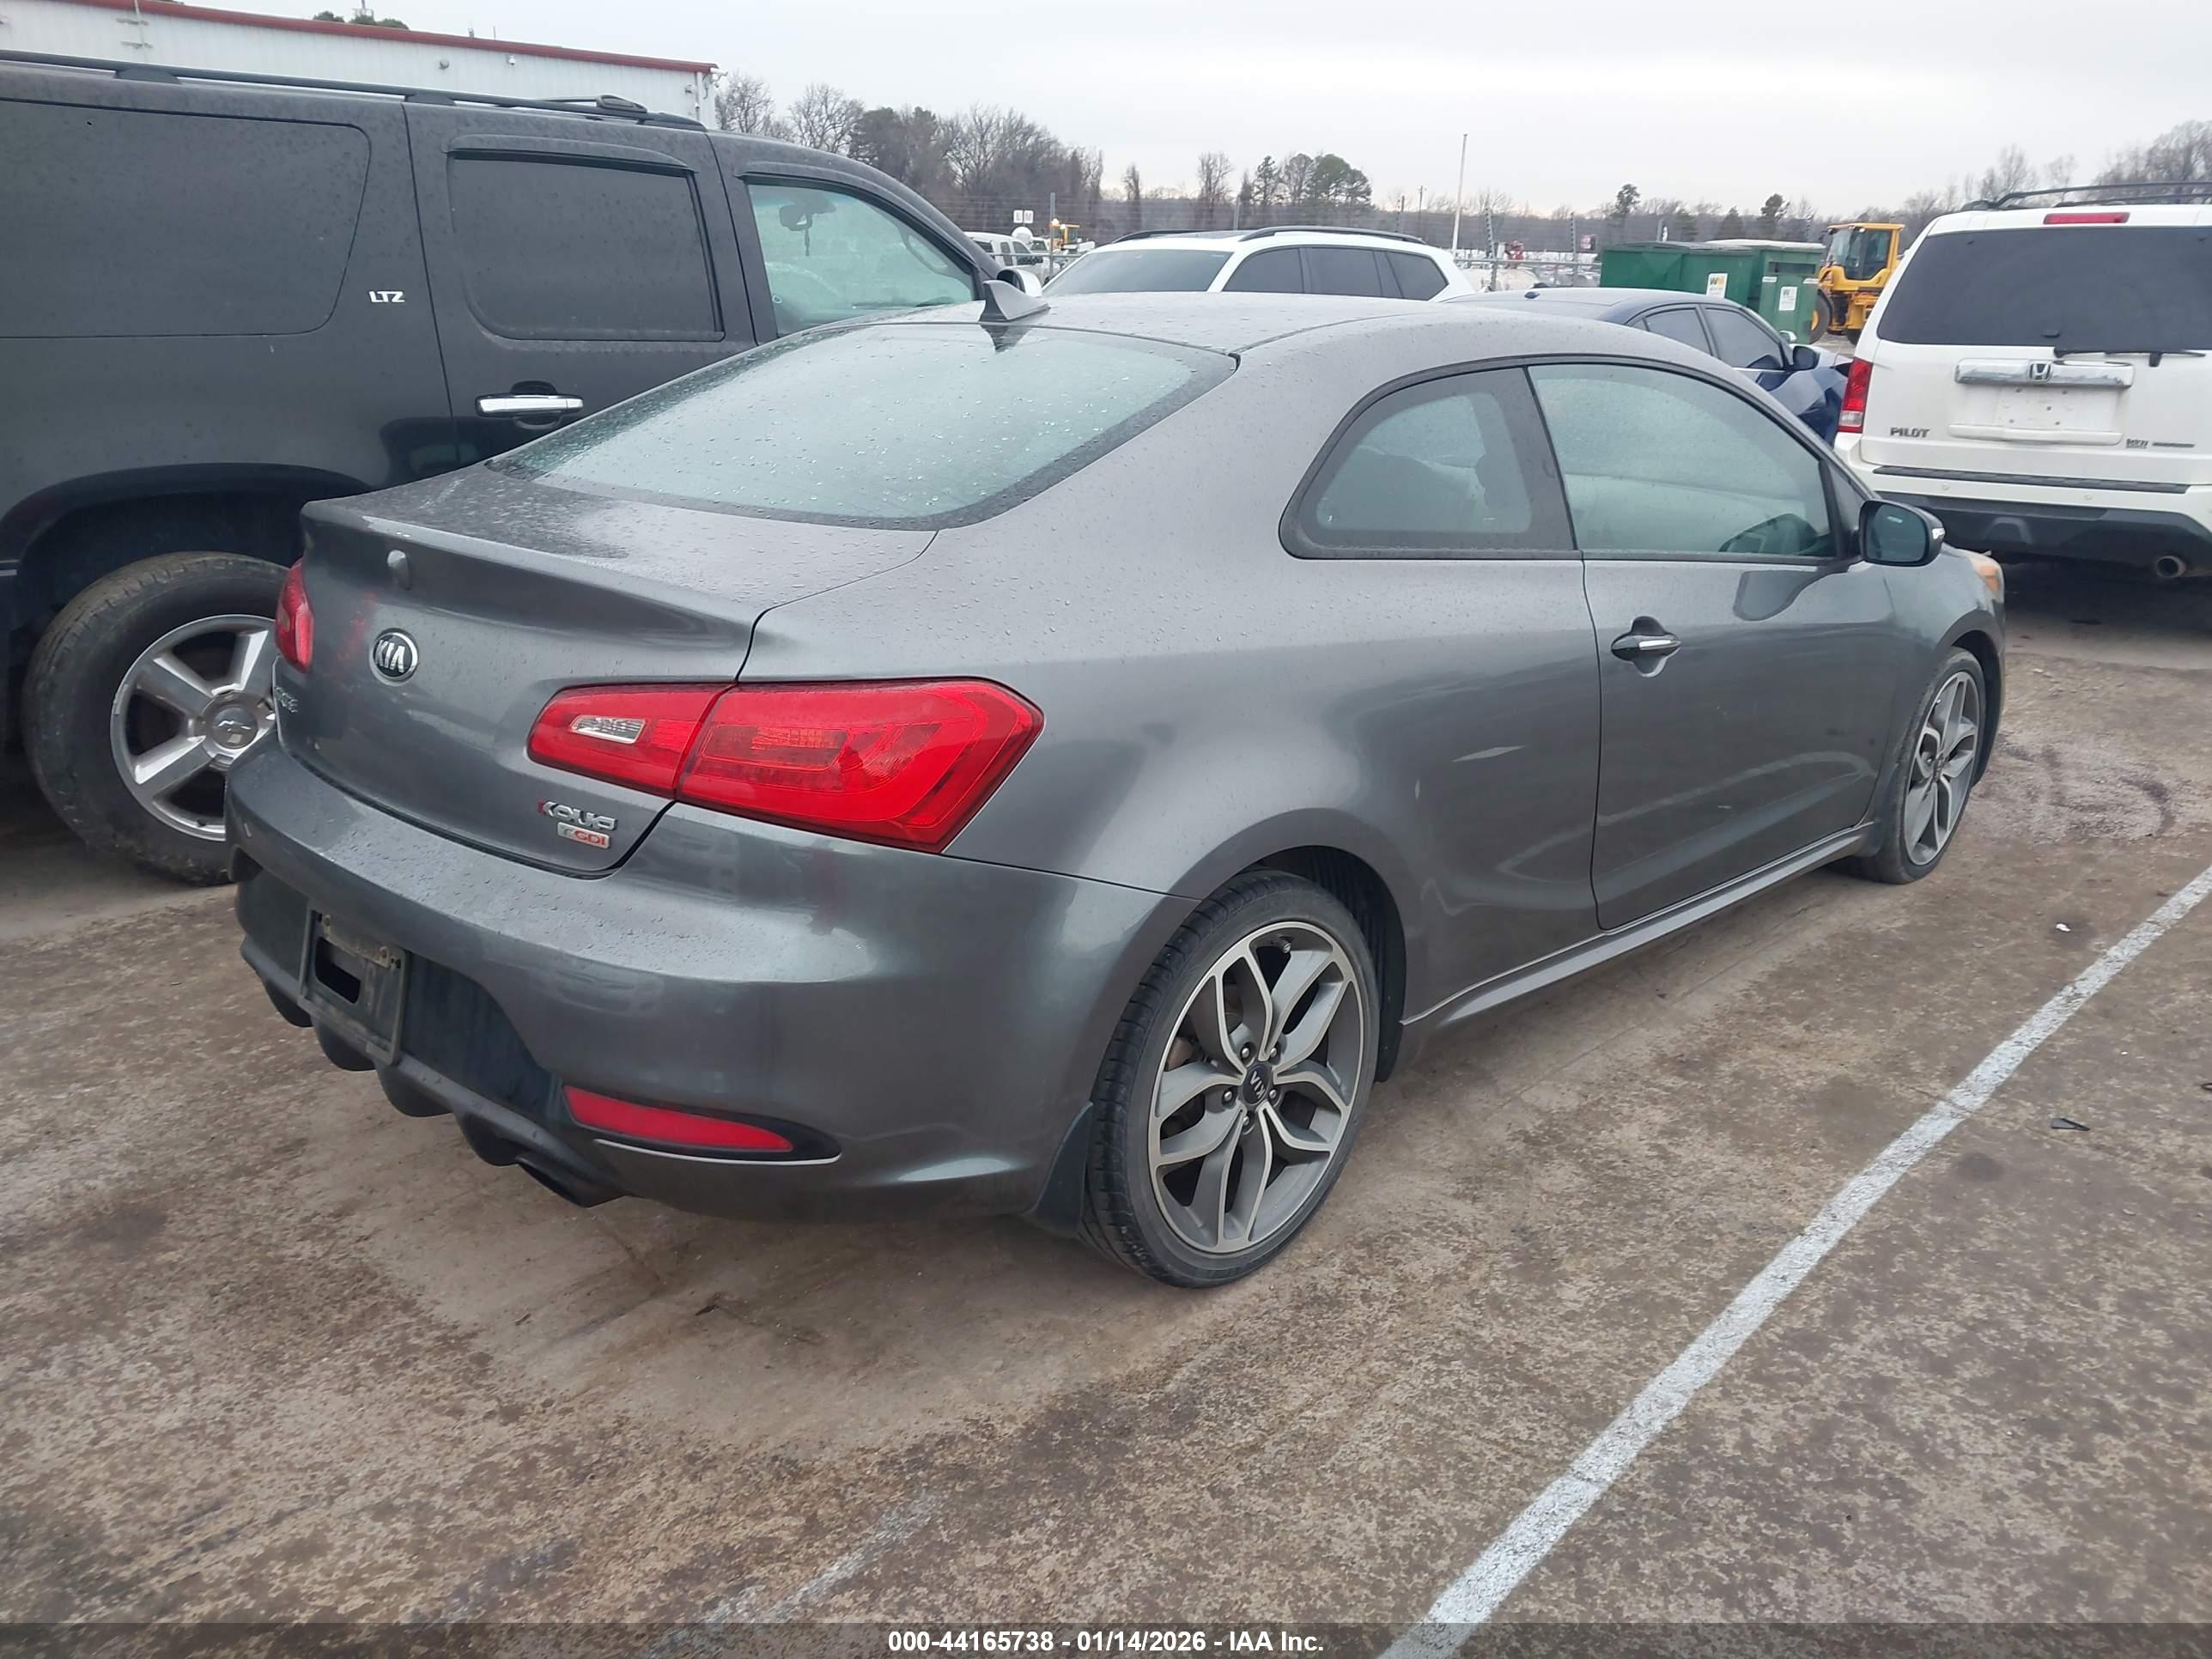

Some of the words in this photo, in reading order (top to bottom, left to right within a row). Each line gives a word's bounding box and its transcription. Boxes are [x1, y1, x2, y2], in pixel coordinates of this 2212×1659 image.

[368, 290, 405, 303] LTZ
[1890, 427, 1931, 438] PILOT
[375, 639, 406, 673] KIA
[1249, 1070, 1266, 1100] KIA
